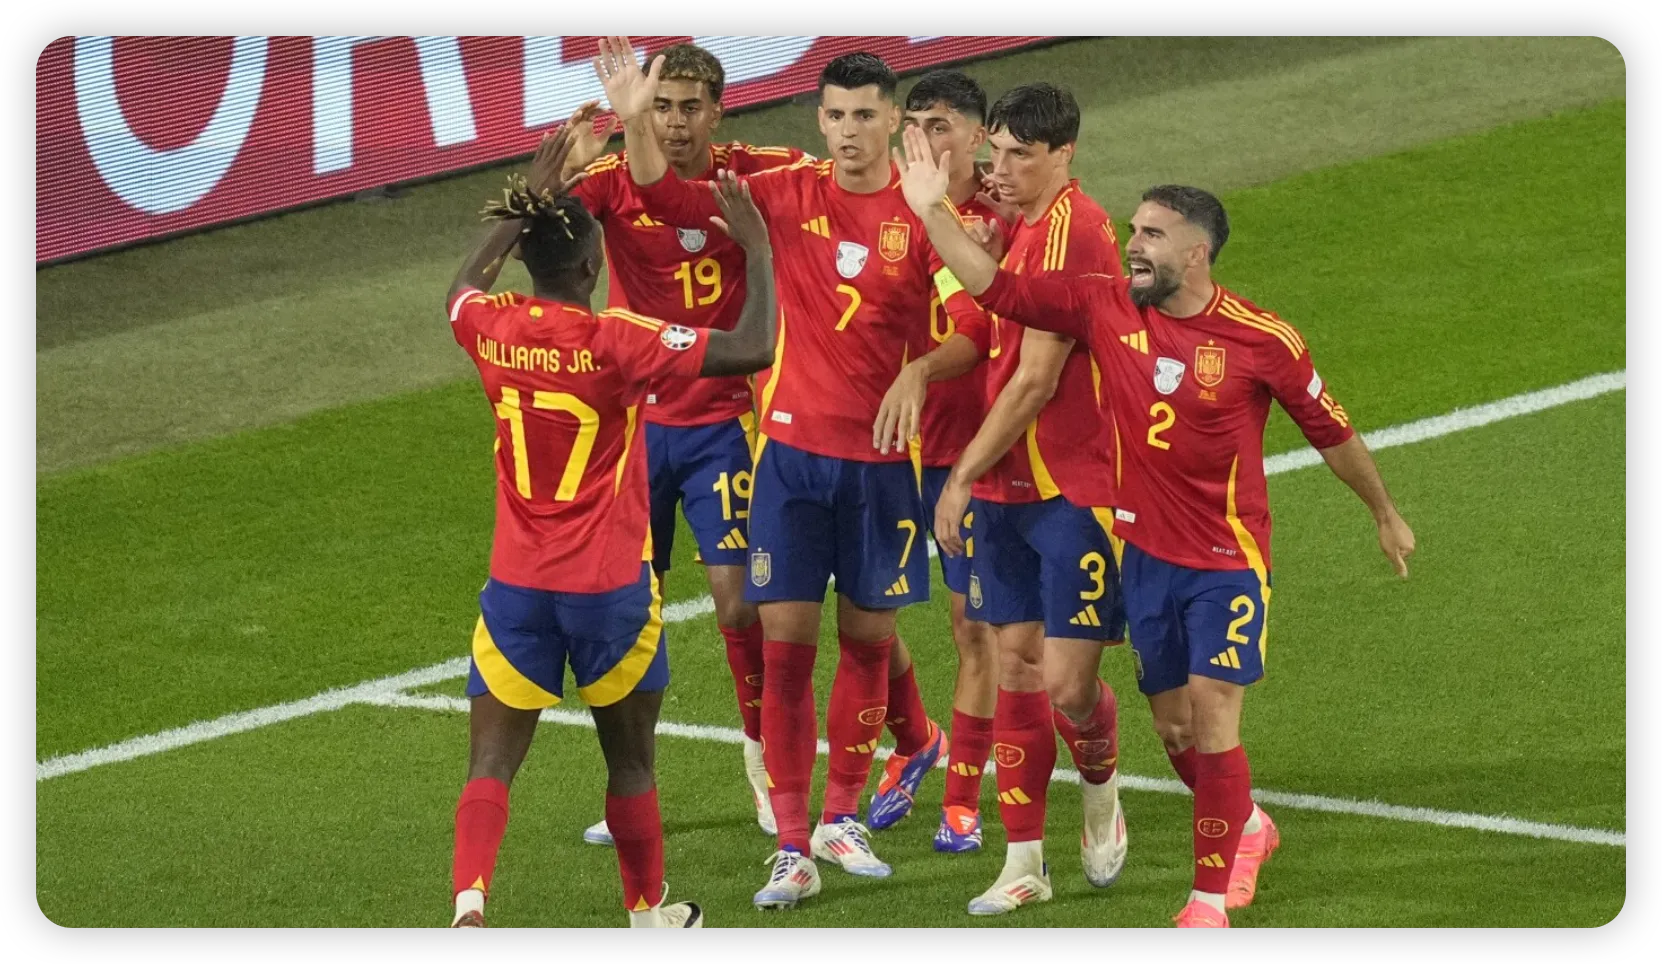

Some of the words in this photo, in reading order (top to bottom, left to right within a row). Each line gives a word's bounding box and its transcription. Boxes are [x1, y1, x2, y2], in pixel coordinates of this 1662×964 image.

[674, 257, 722, 309] 19
[835, 284, 861, 331] 7
[476, 333, 561, 373] WILLIAMS
[567, 348, 602, 374] JR.
[494, 386, 600, 502] 17
[1147, 401, 1176, 451] 2
[712, 470, 751, 521] 19
[898, 519, 916, 568] 7
[1079, 552, 1105, 600] 3
[1227, 594, 1255, 645] 2
